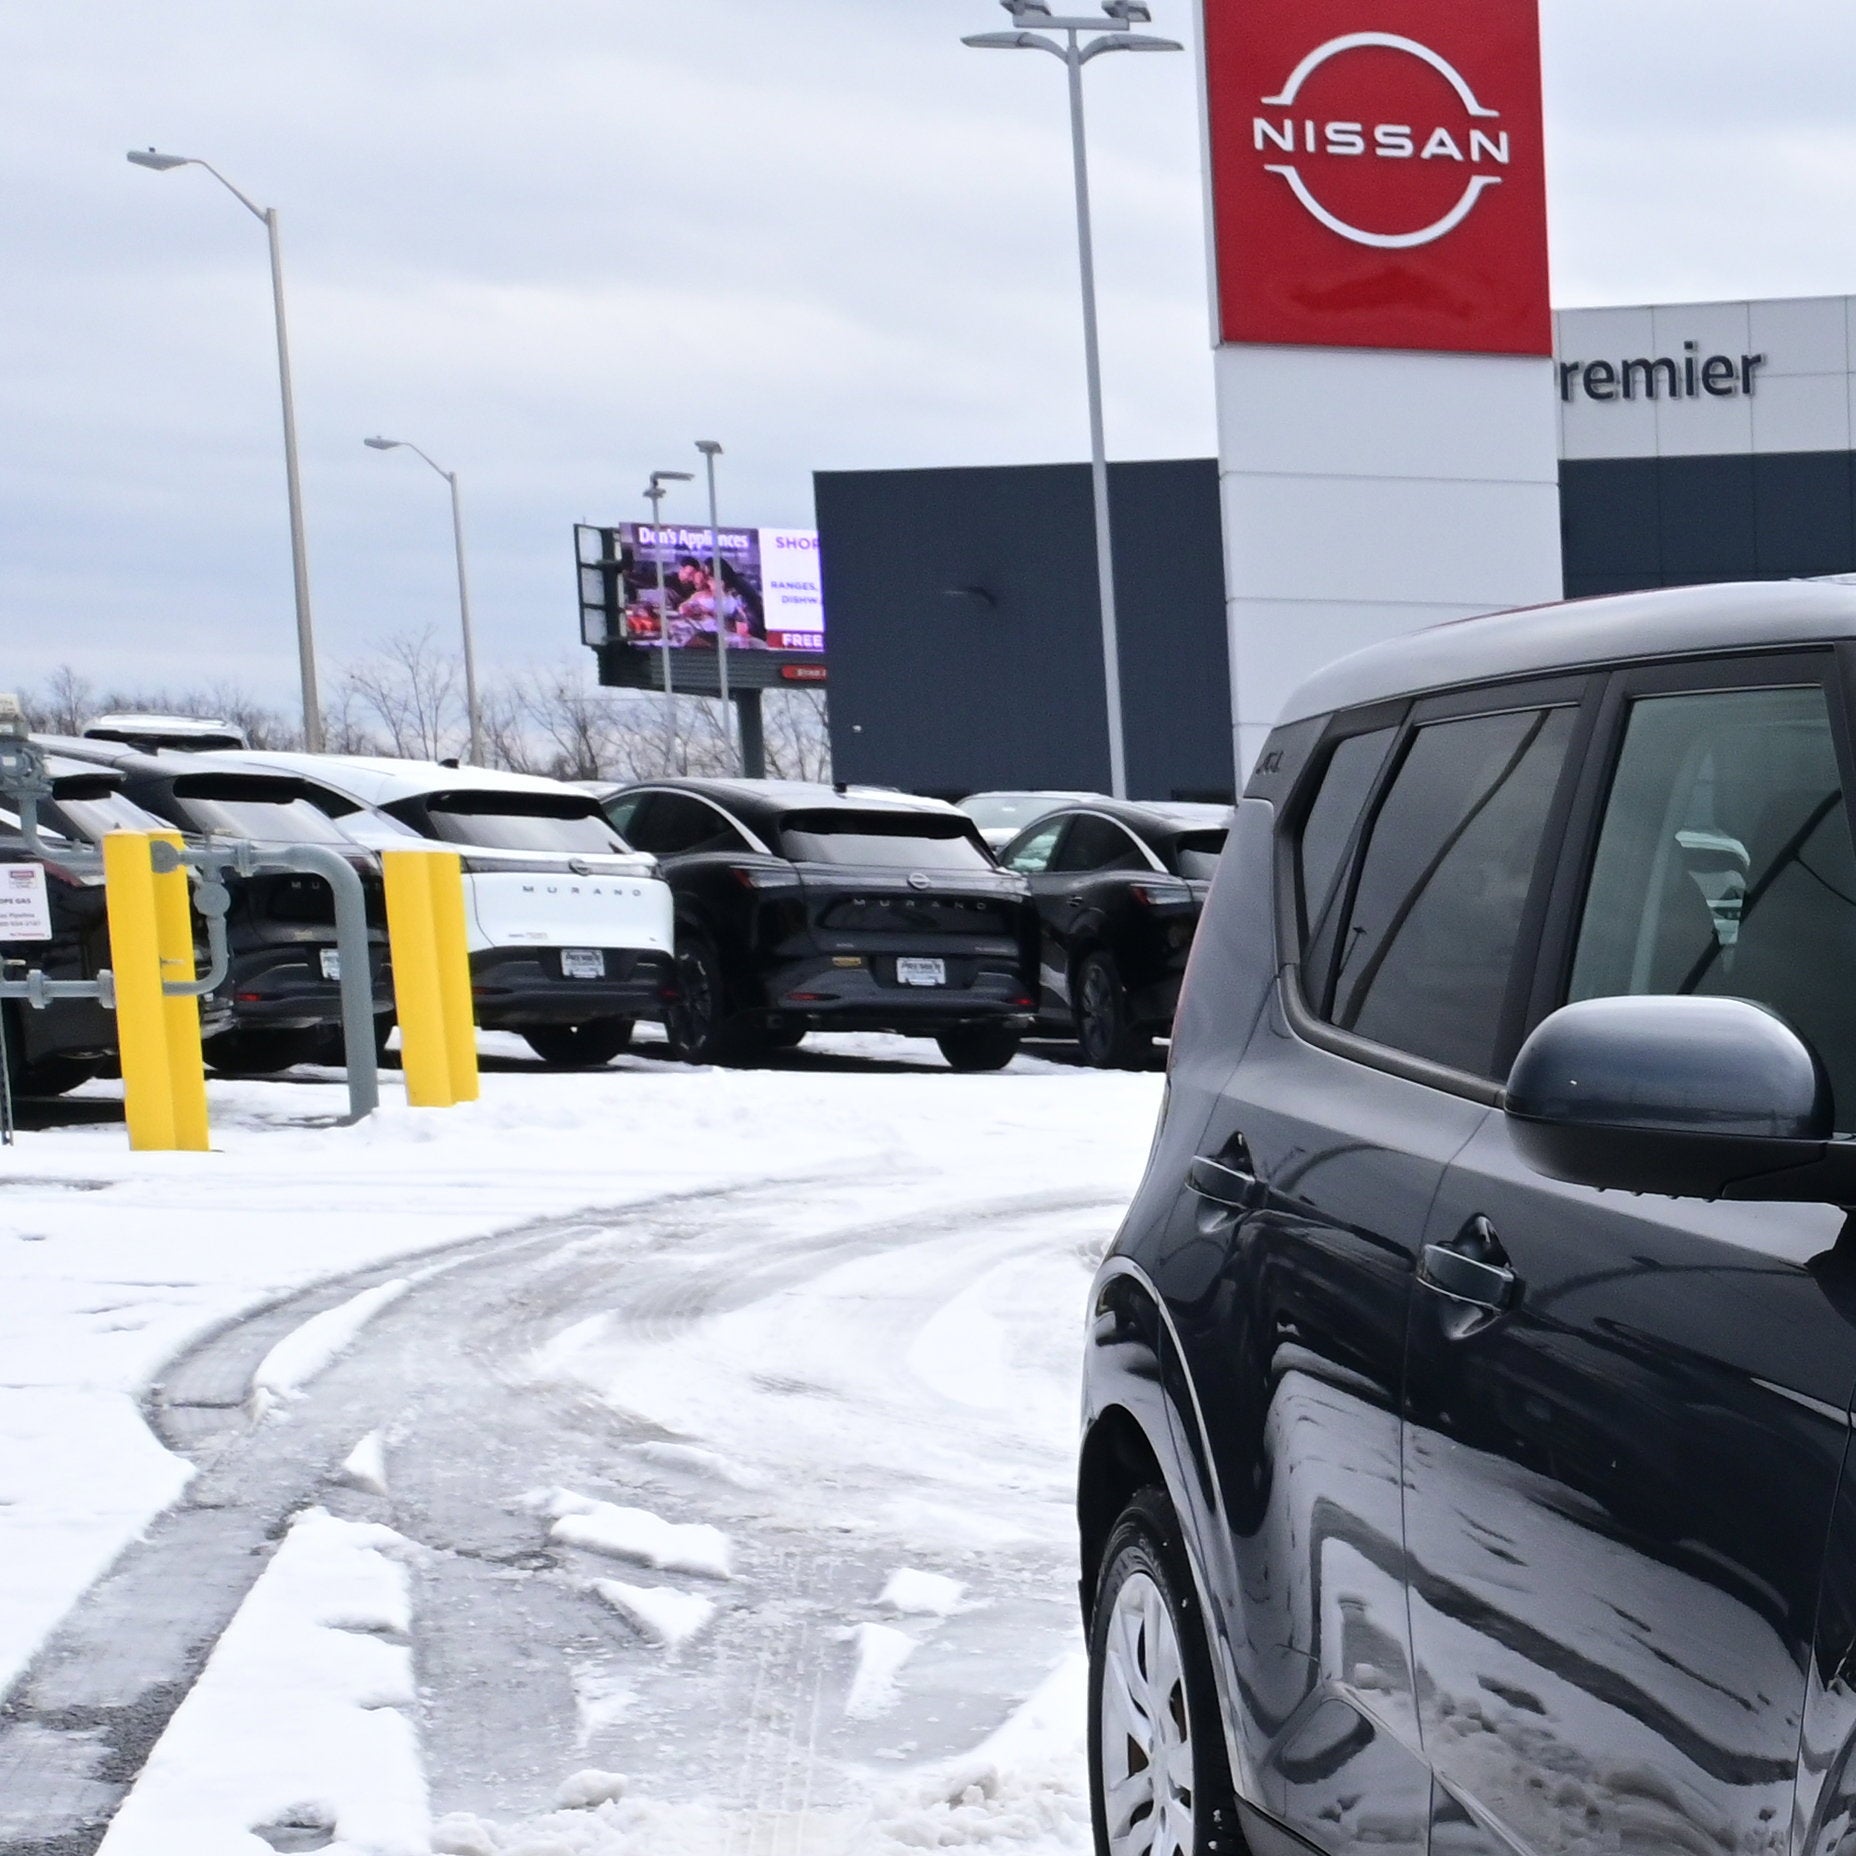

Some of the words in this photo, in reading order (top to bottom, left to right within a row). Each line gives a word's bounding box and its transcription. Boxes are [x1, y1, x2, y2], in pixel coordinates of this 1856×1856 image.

[1253, 117, 1510, 164] NISSAN
[1559, 341, 1764, 402] remier
[679, 529, 749, 550] Applinces
[781, 633, 823, 647] FREE
[523, 885, 641, 897] MURANO
[853, 898, 986, 910] MURANO
